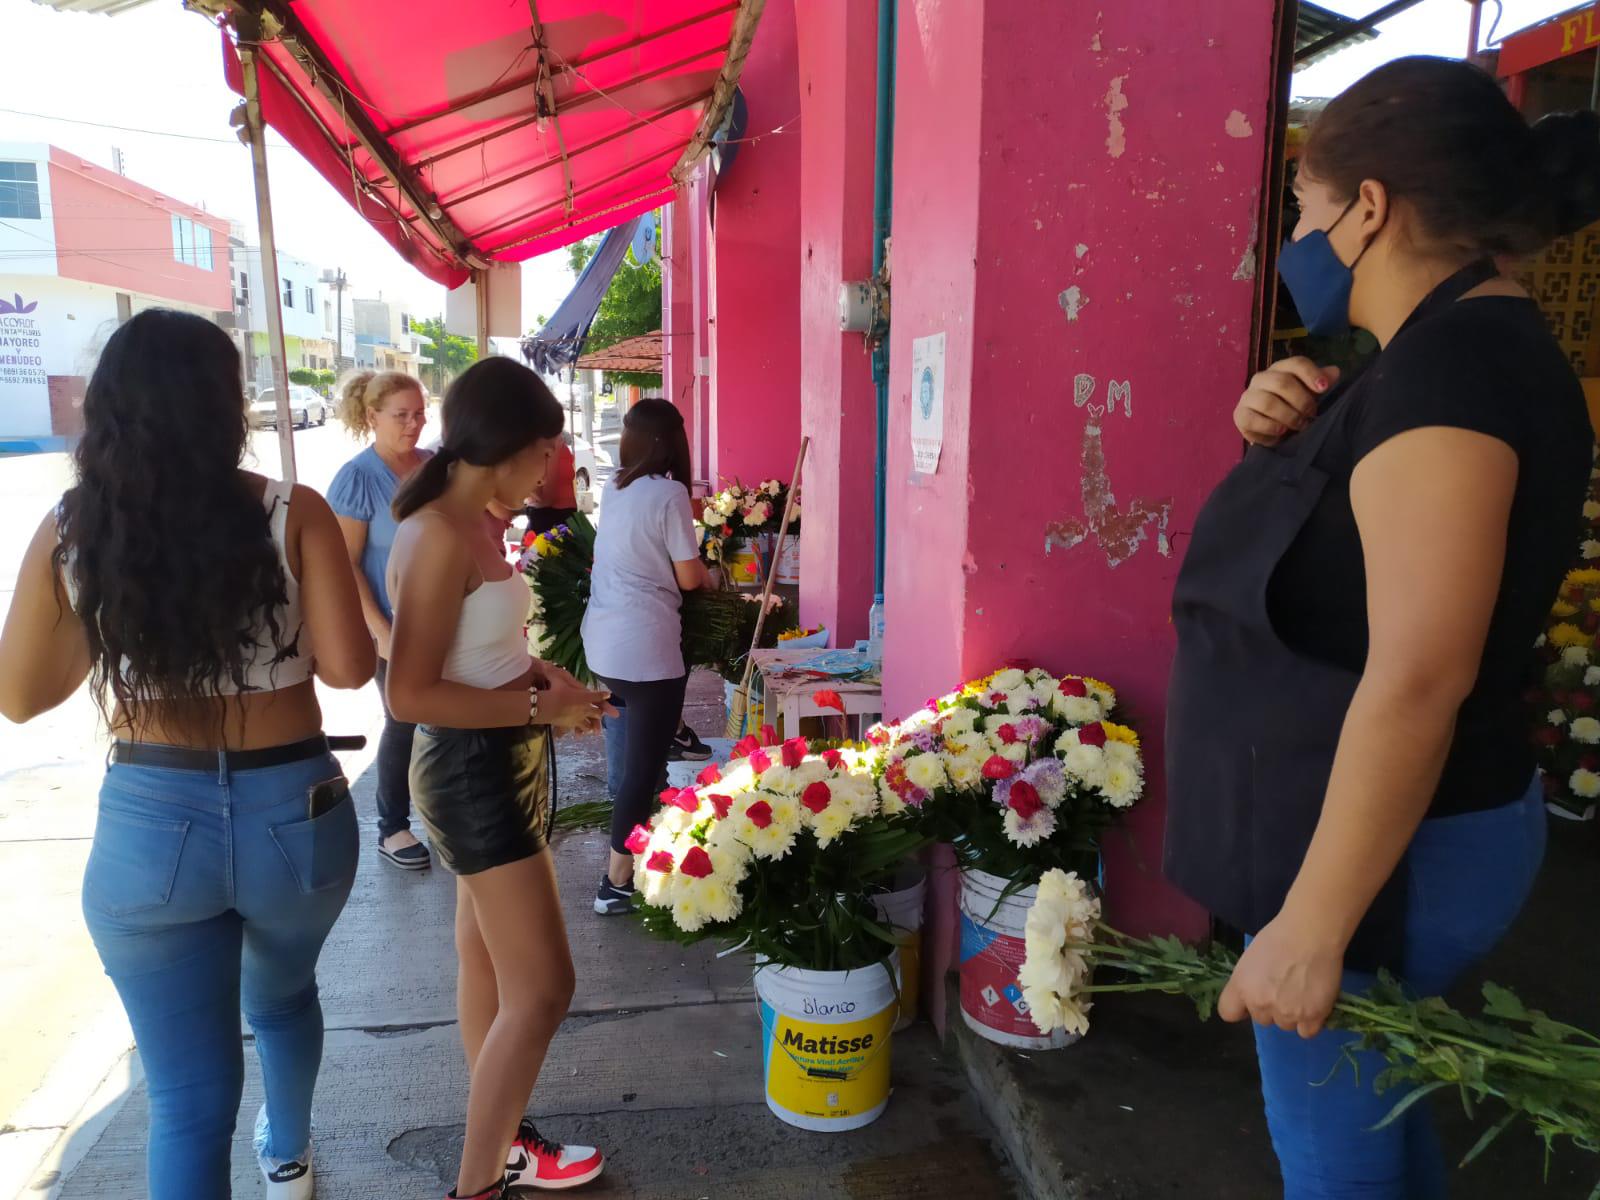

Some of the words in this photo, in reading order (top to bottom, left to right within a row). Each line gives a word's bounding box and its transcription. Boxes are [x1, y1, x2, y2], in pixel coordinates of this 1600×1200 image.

[1561, 10, 1600, 52] FL
[803, 998, 856, 1016] blanco
[783, 1029, 874, 1055] Matisse
